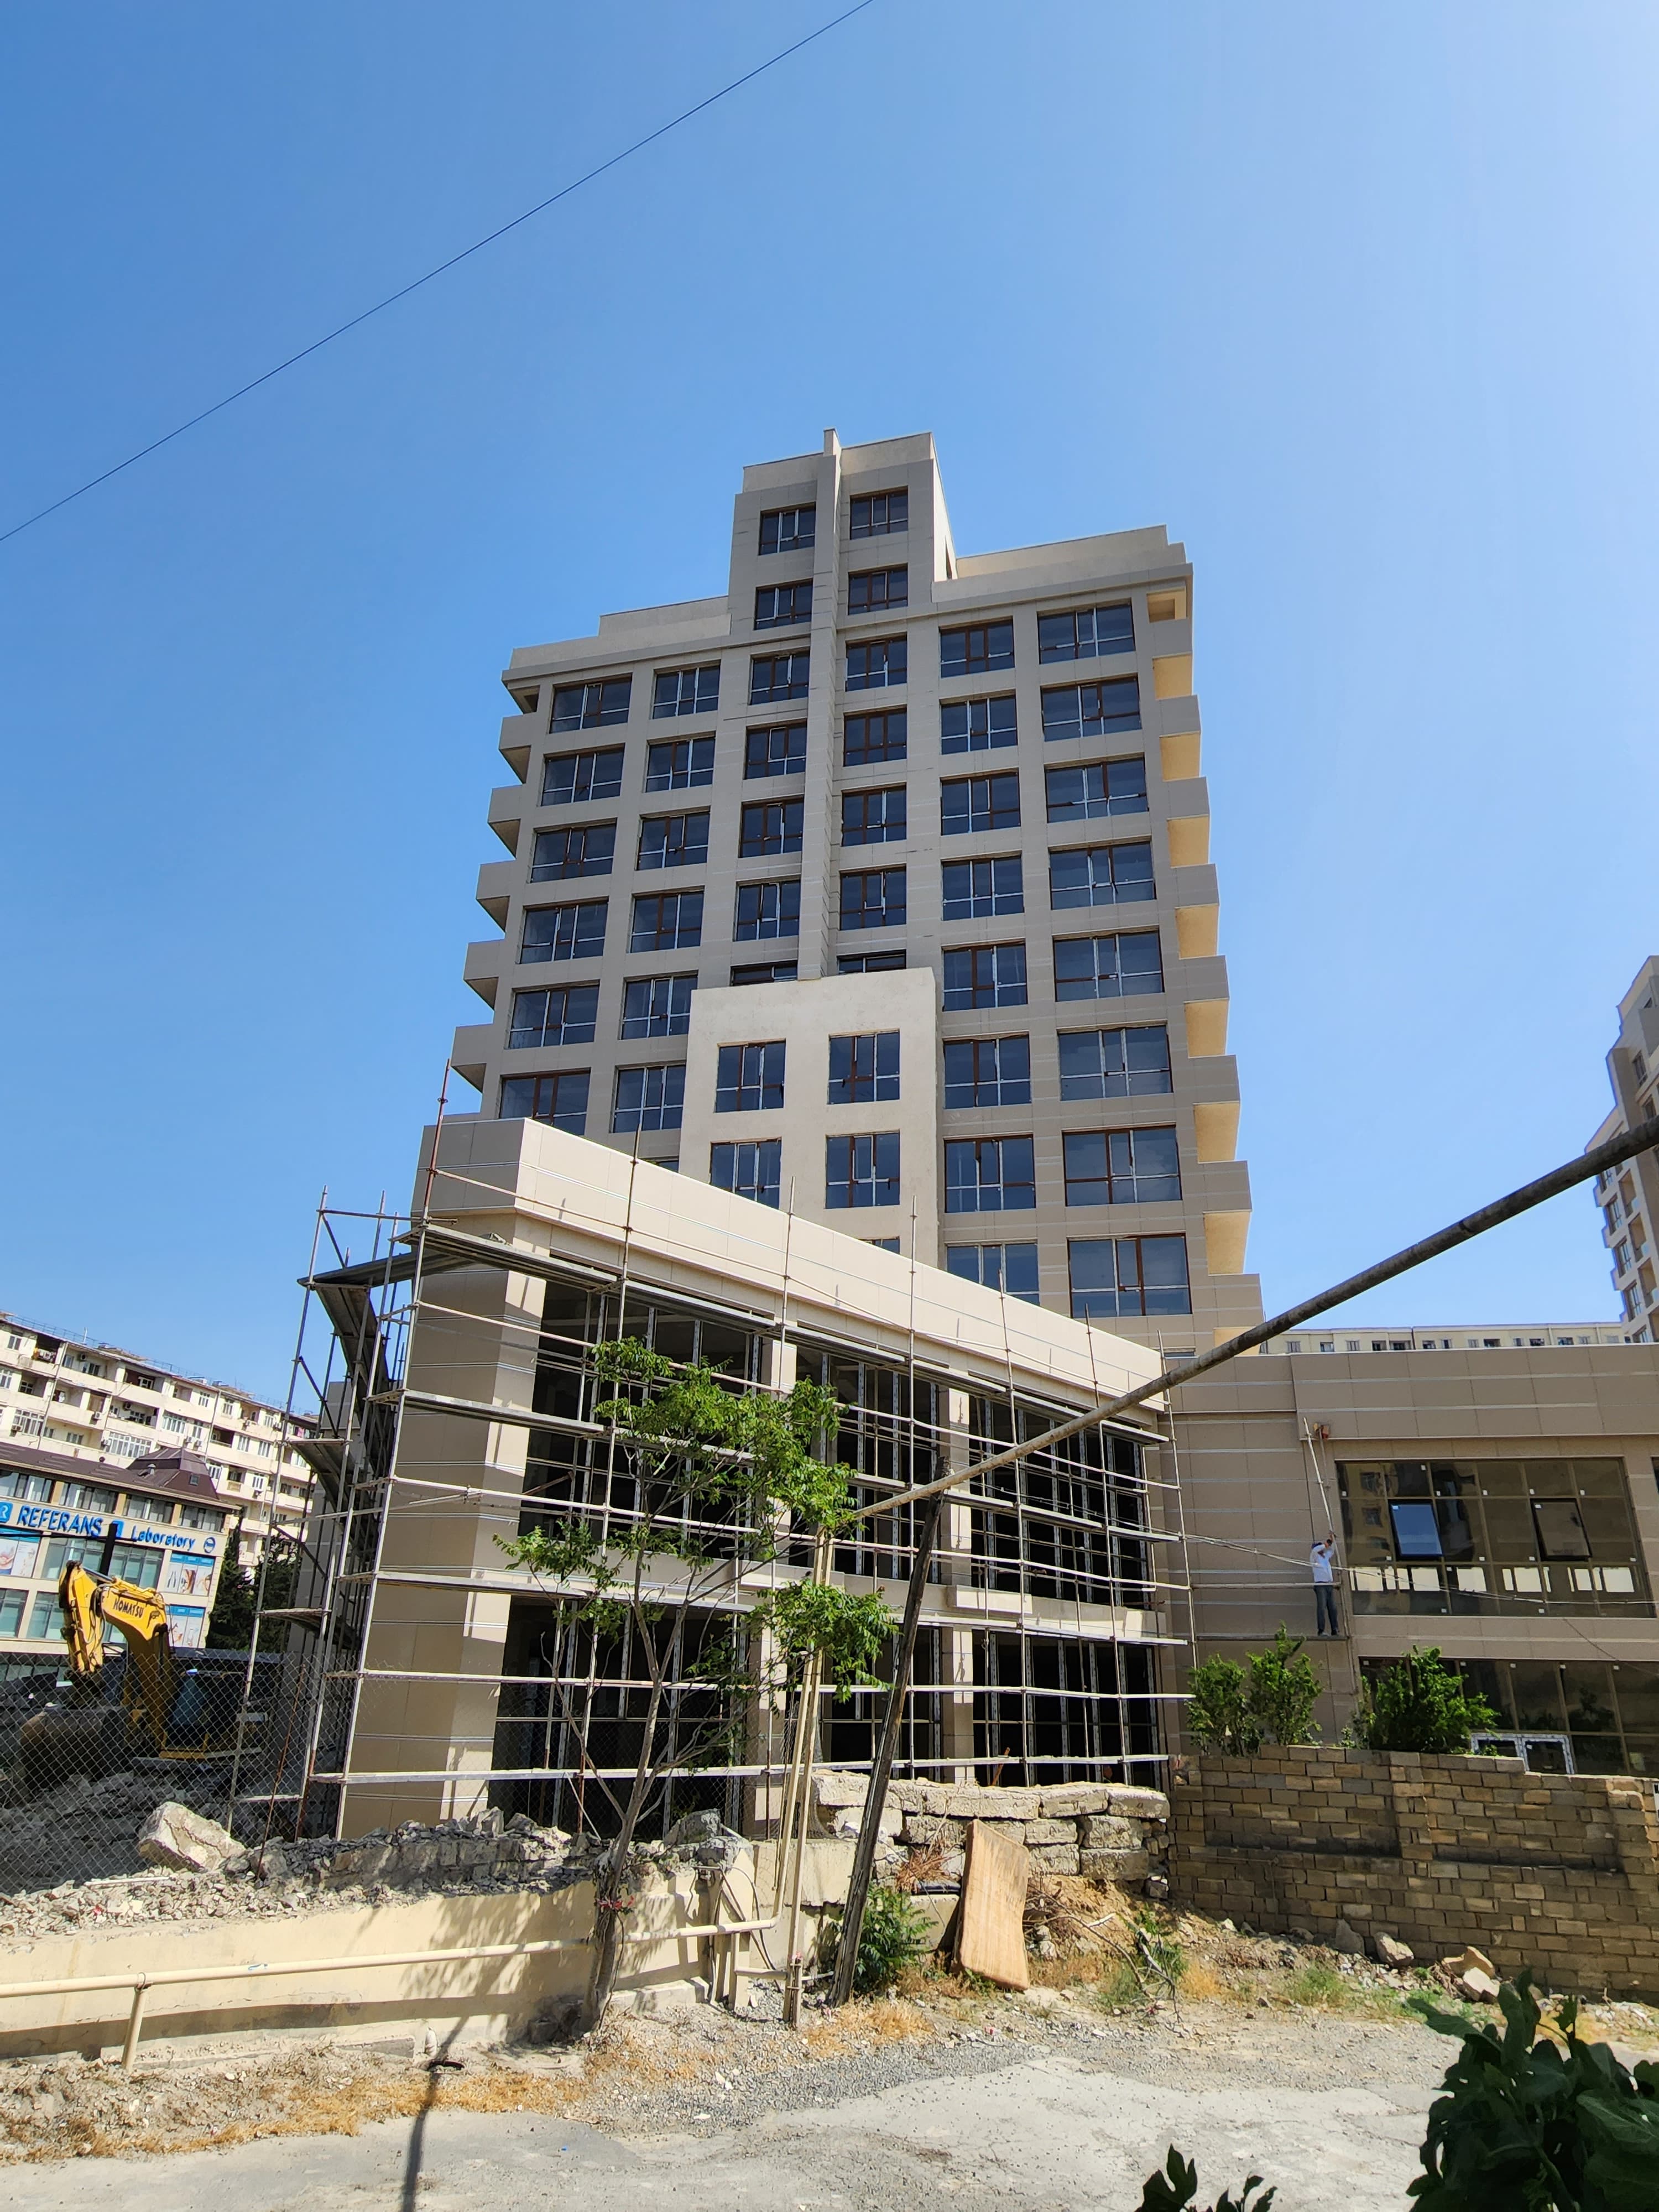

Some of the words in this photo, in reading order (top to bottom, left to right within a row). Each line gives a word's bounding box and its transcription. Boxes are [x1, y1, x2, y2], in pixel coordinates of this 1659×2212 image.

[17, 1505, 103, 1538] REFERANS
[131, 1525, 196, 1551] Laboratory
[113, 1598, 144, 1618] KOMATSU
